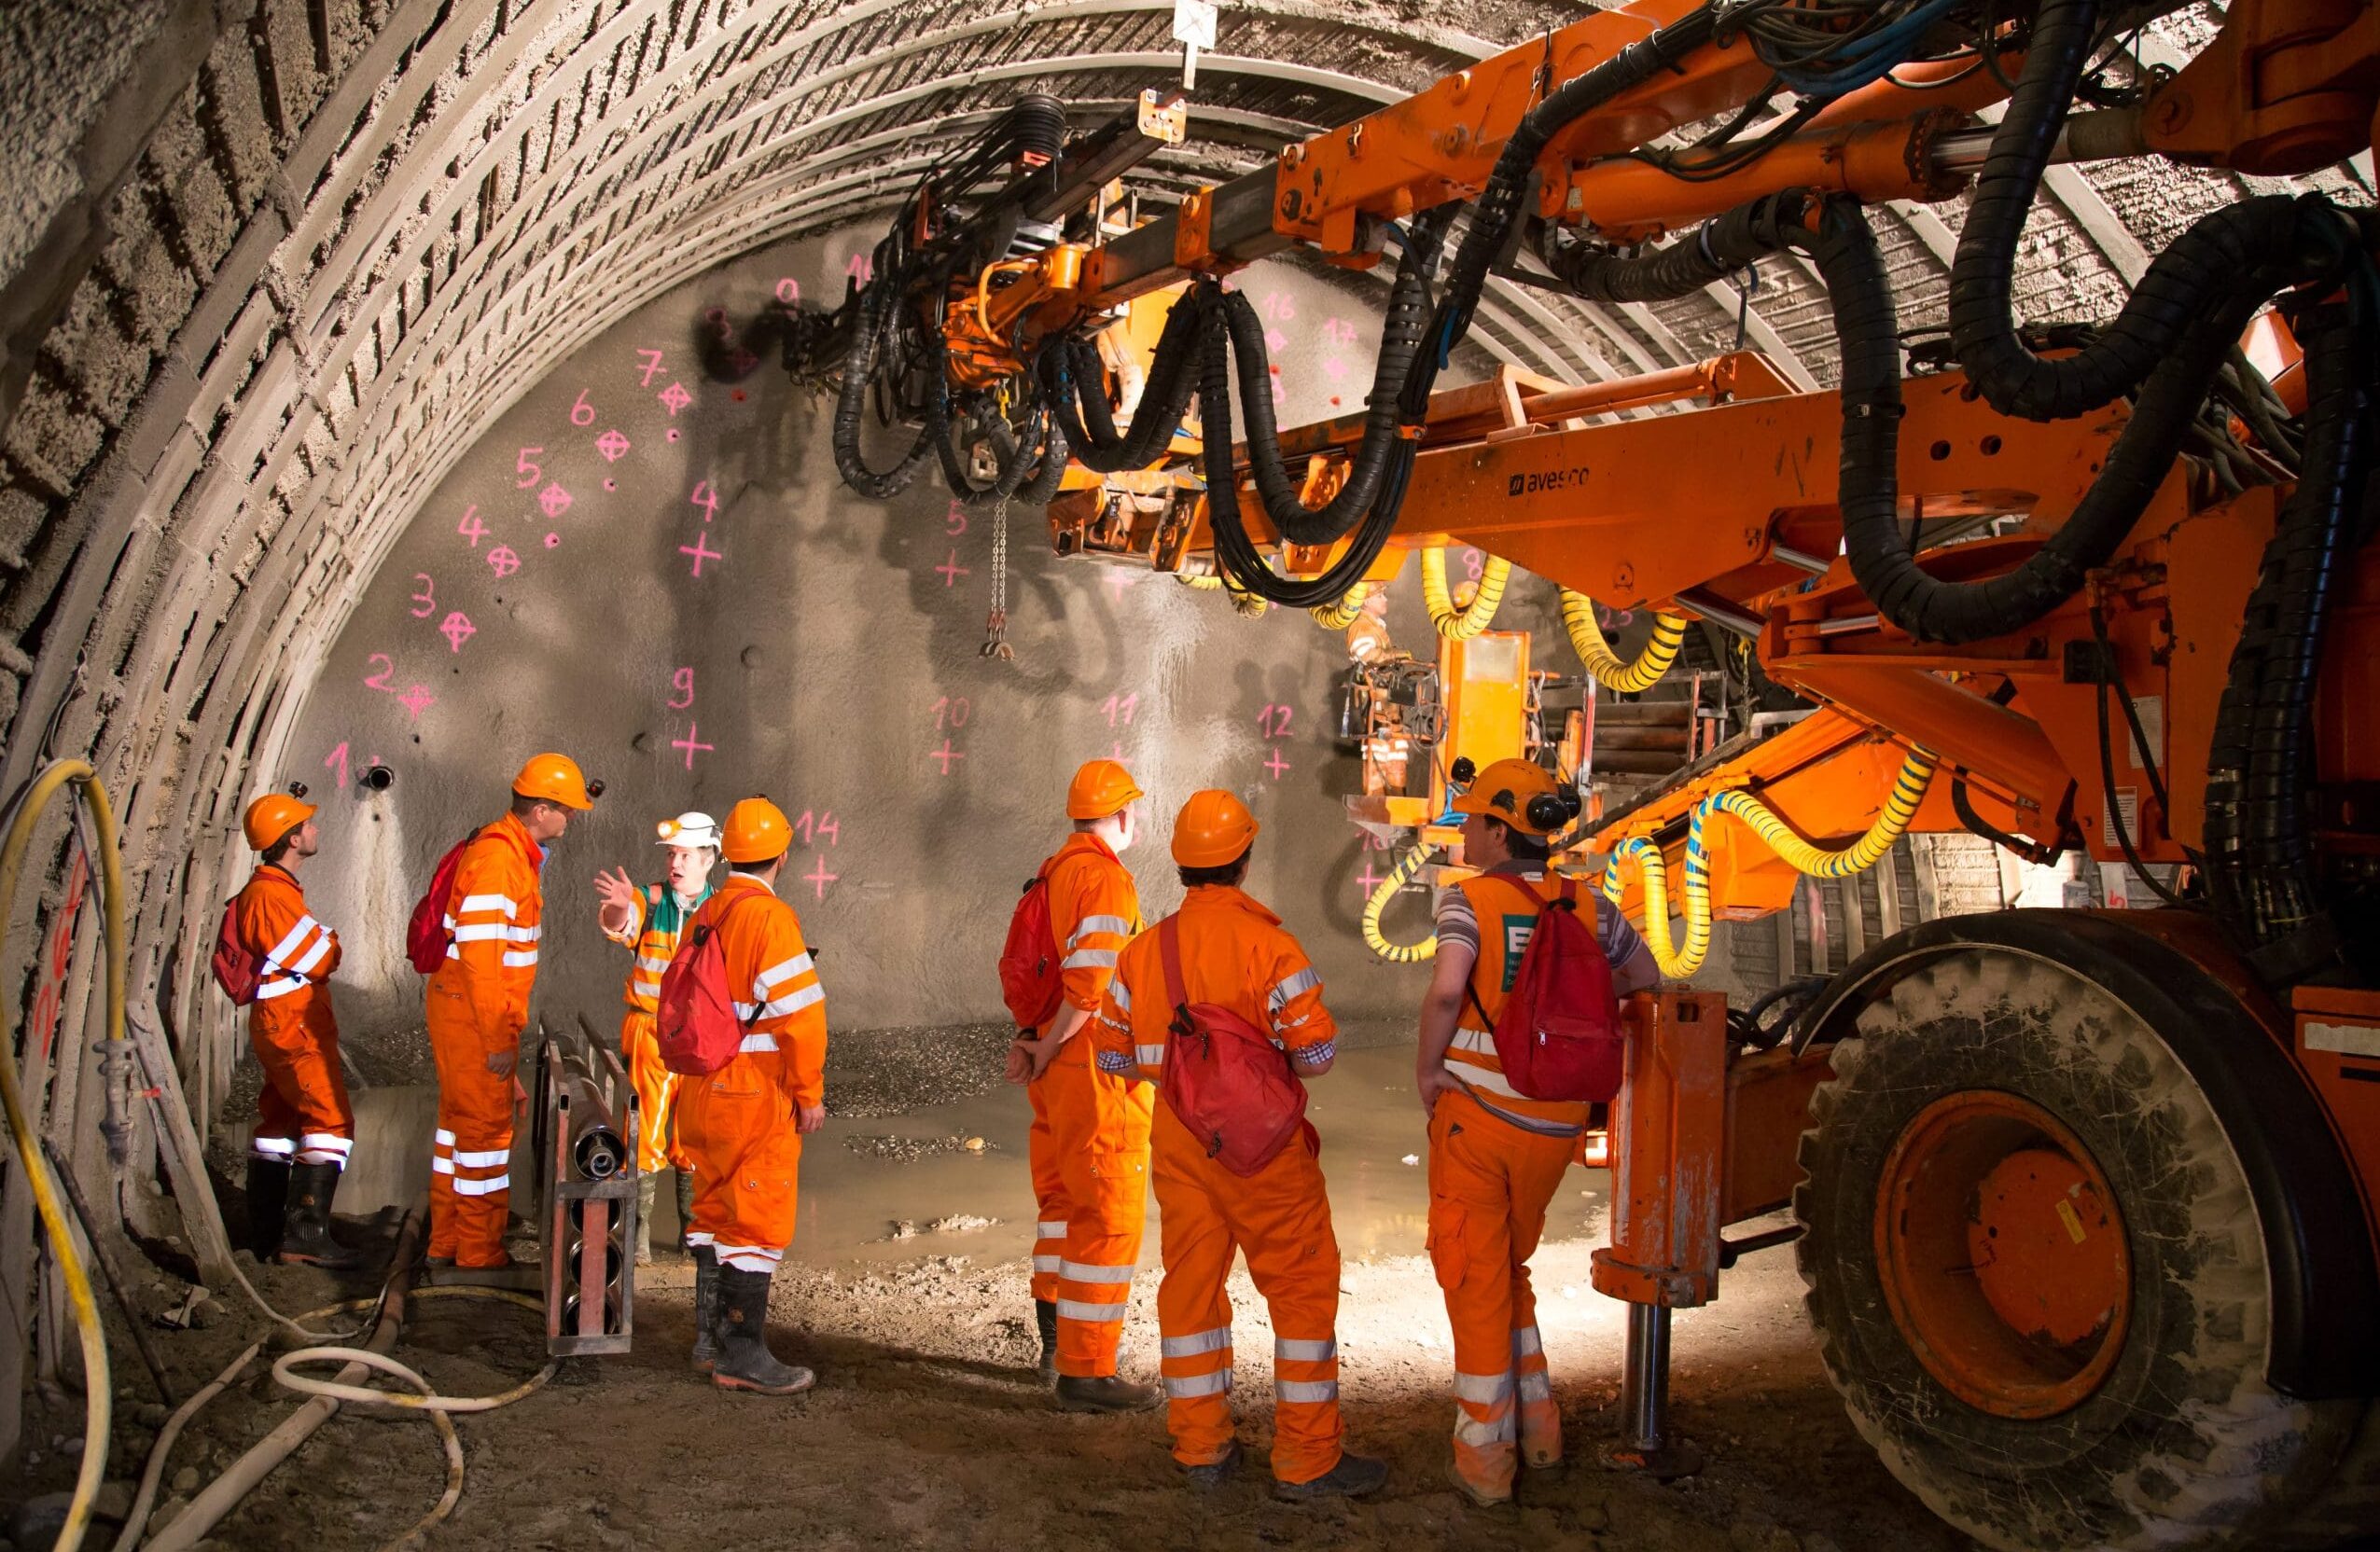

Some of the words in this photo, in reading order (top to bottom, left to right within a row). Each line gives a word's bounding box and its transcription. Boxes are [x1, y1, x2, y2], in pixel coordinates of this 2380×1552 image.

[1263, 292, 1296, 322] 16
[1324, 316, 1358, 349] 17
[635, 350, 668, 387] 7
[570, 388, 597, 426] 6
[516, 447, 545, 490] 5
[689, 479, 719, 524] 4
[946, 499, 968, 536] 5
[457, 505, 492, 547] 4
[1462, 547, 1482, 580] 8
[411, 573, 437, 618] 3
[363, 653, 397, 693] 2
[666, 666, 695, 710] 9
[929, 696, 970, 730] 10
[1101, 691, 1138, 728] 11
[1257, 703, 1295, 739] 12
[325, 741, 349, 789] 1
[796, 811, 840, 847] 14
